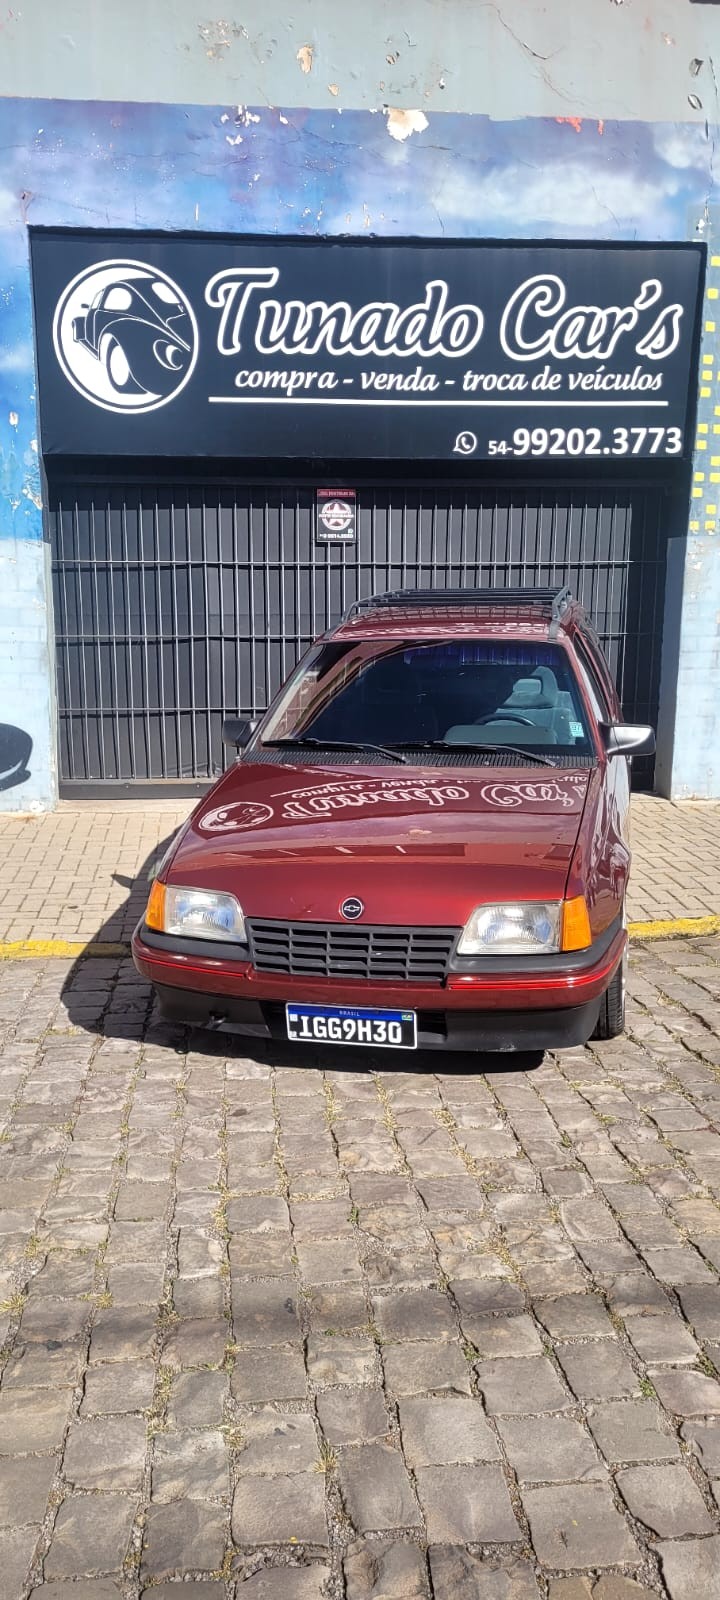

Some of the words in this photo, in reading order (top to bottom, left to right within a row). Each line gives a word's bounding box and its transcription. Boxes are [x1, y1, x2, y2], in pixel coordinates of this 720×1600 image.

[204, 266, 484, 358] Tunado
[499, 273, 684, 361] Car's
[234, 369, 339, 396] compra
[360, 366, 440, 391] venda
[462, 370, 528, 391] troca
[531, 365, 562, 390] de
[568, 365, 664, 390] veículos
[299, 1015, 402, 1044] IGG9H30
